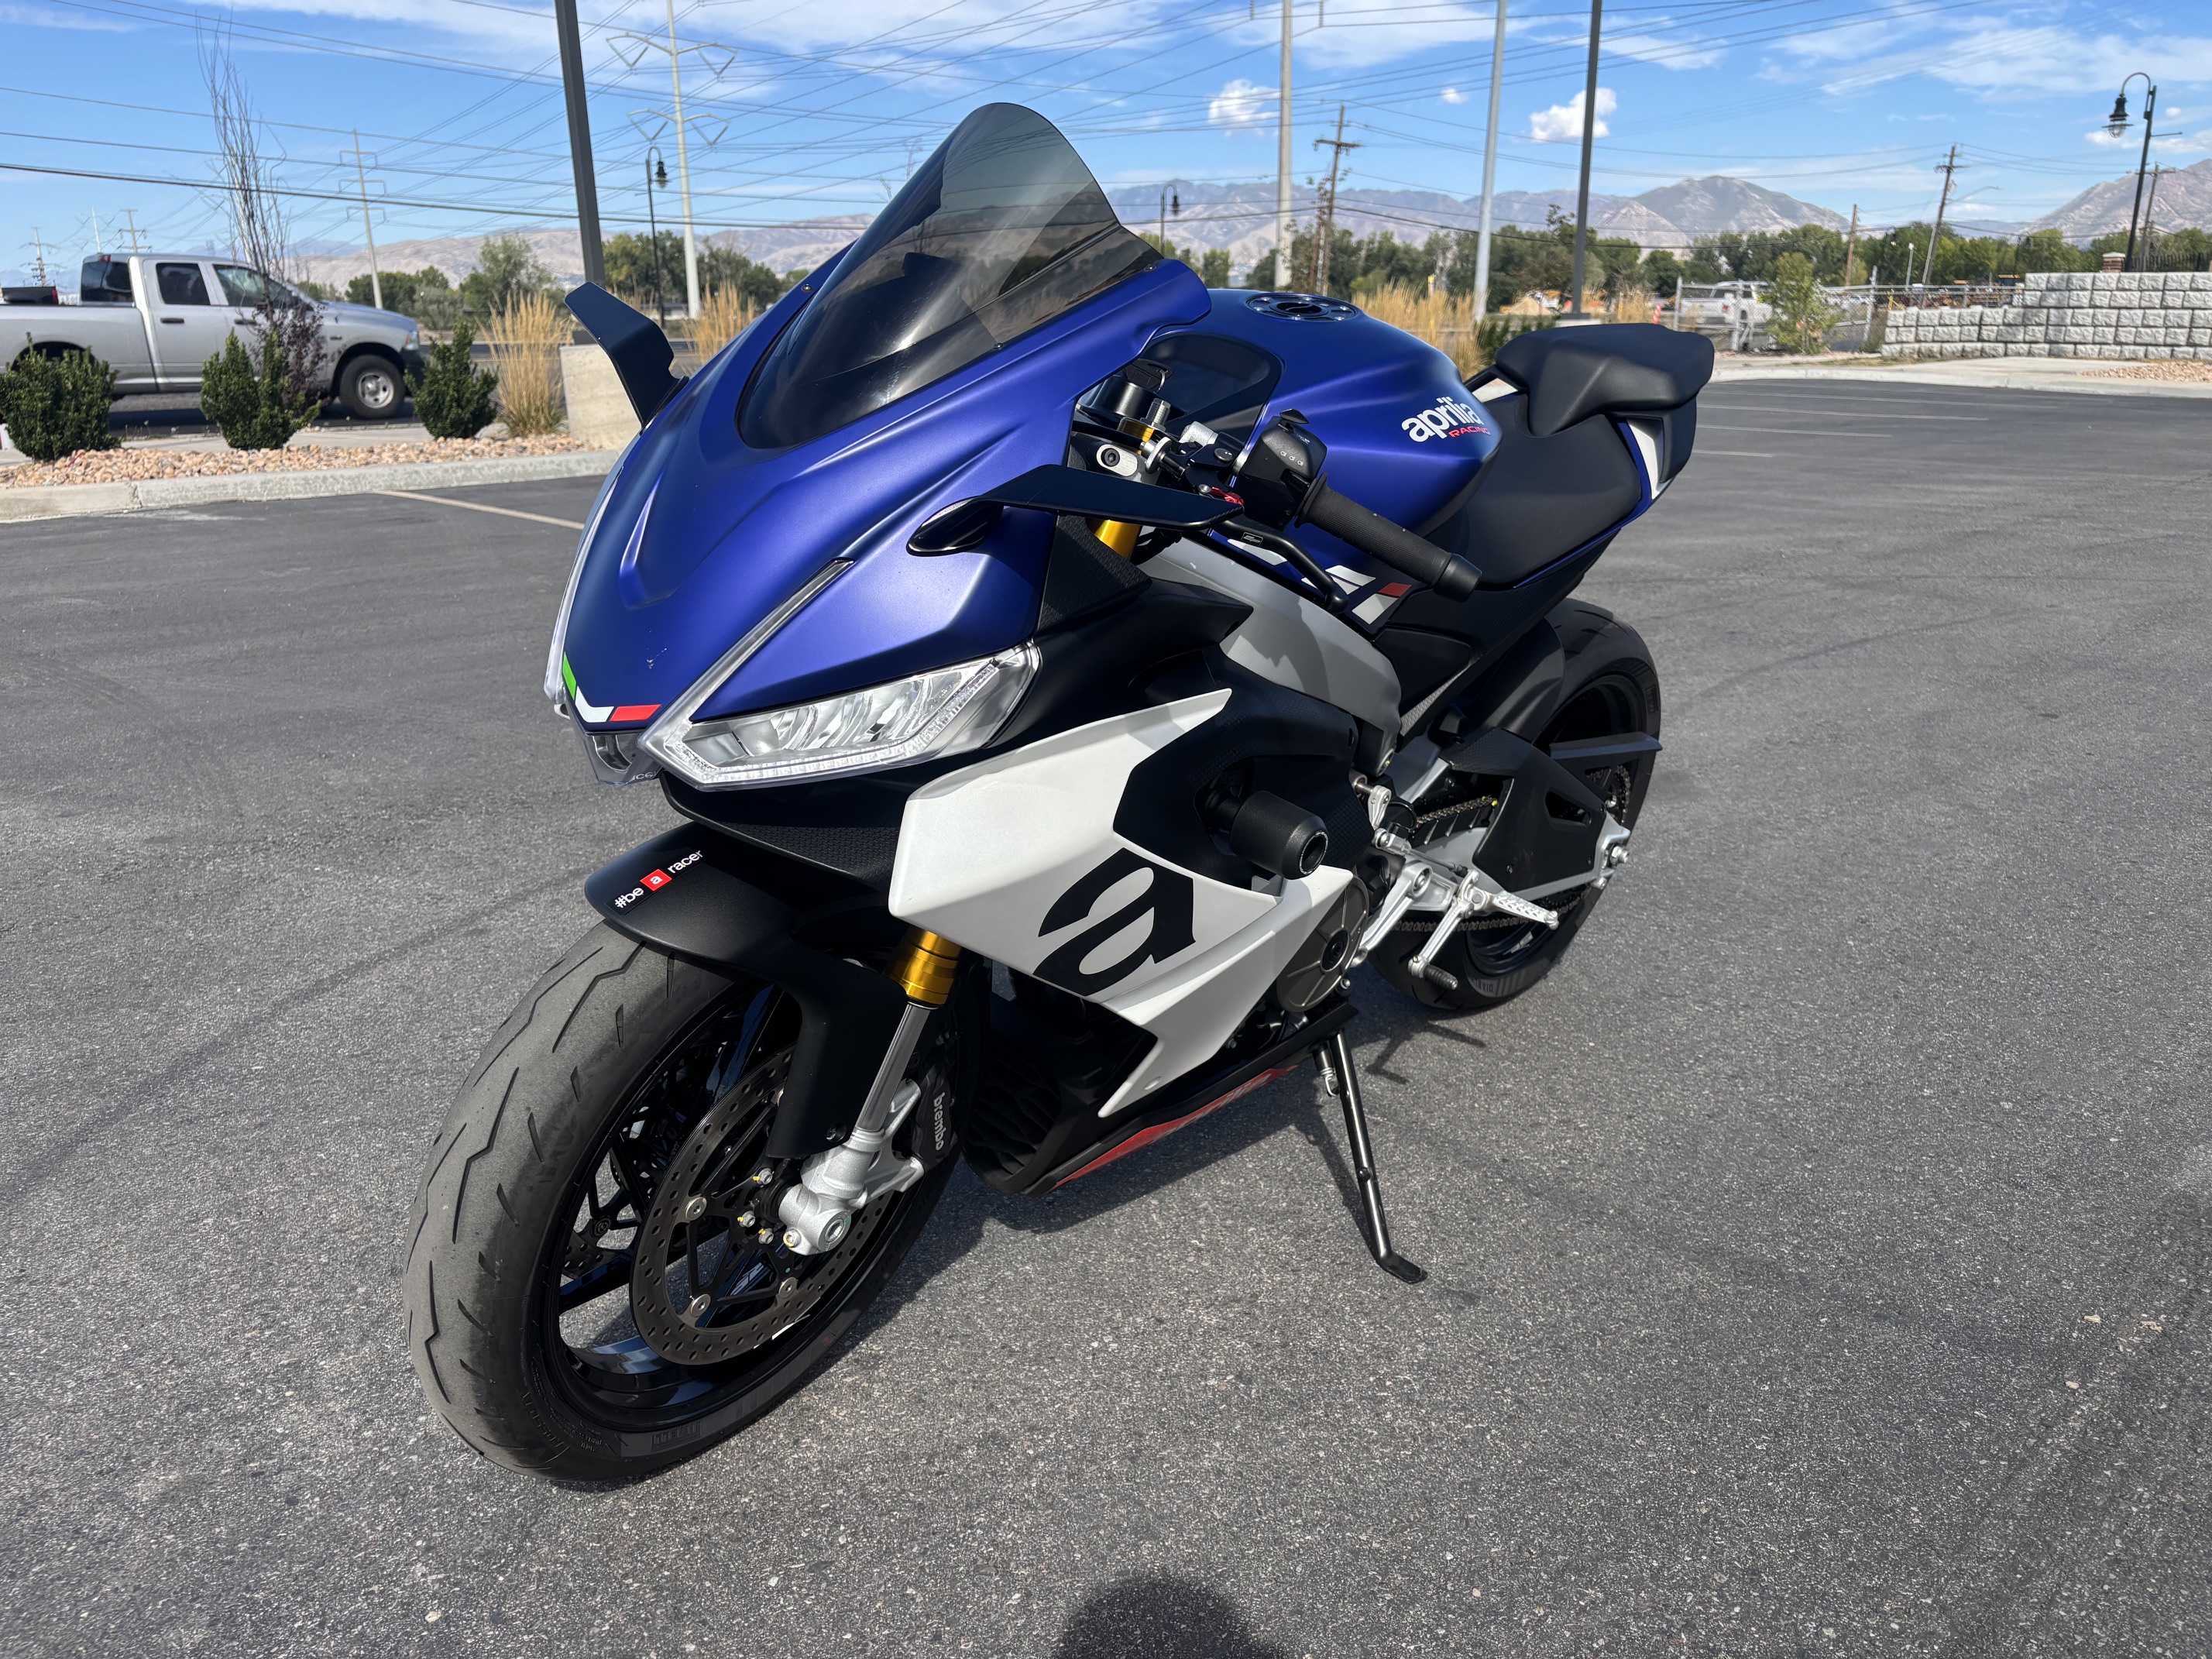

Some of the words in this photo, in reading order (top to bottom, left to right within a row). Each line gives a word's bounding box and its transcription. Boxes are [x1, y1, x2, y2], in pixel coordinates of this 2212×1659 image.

[1401, 396, 1484, 442] aprilia
[1448, 425, 1492, 438] RACING
[614, 887, 644, 908] #be
[650, 875, 663, 884] a
[667, 850, 703, 874] racer
[1032, 847, 1197, 996] a
[933, 1091, 947, 1151] brembo
